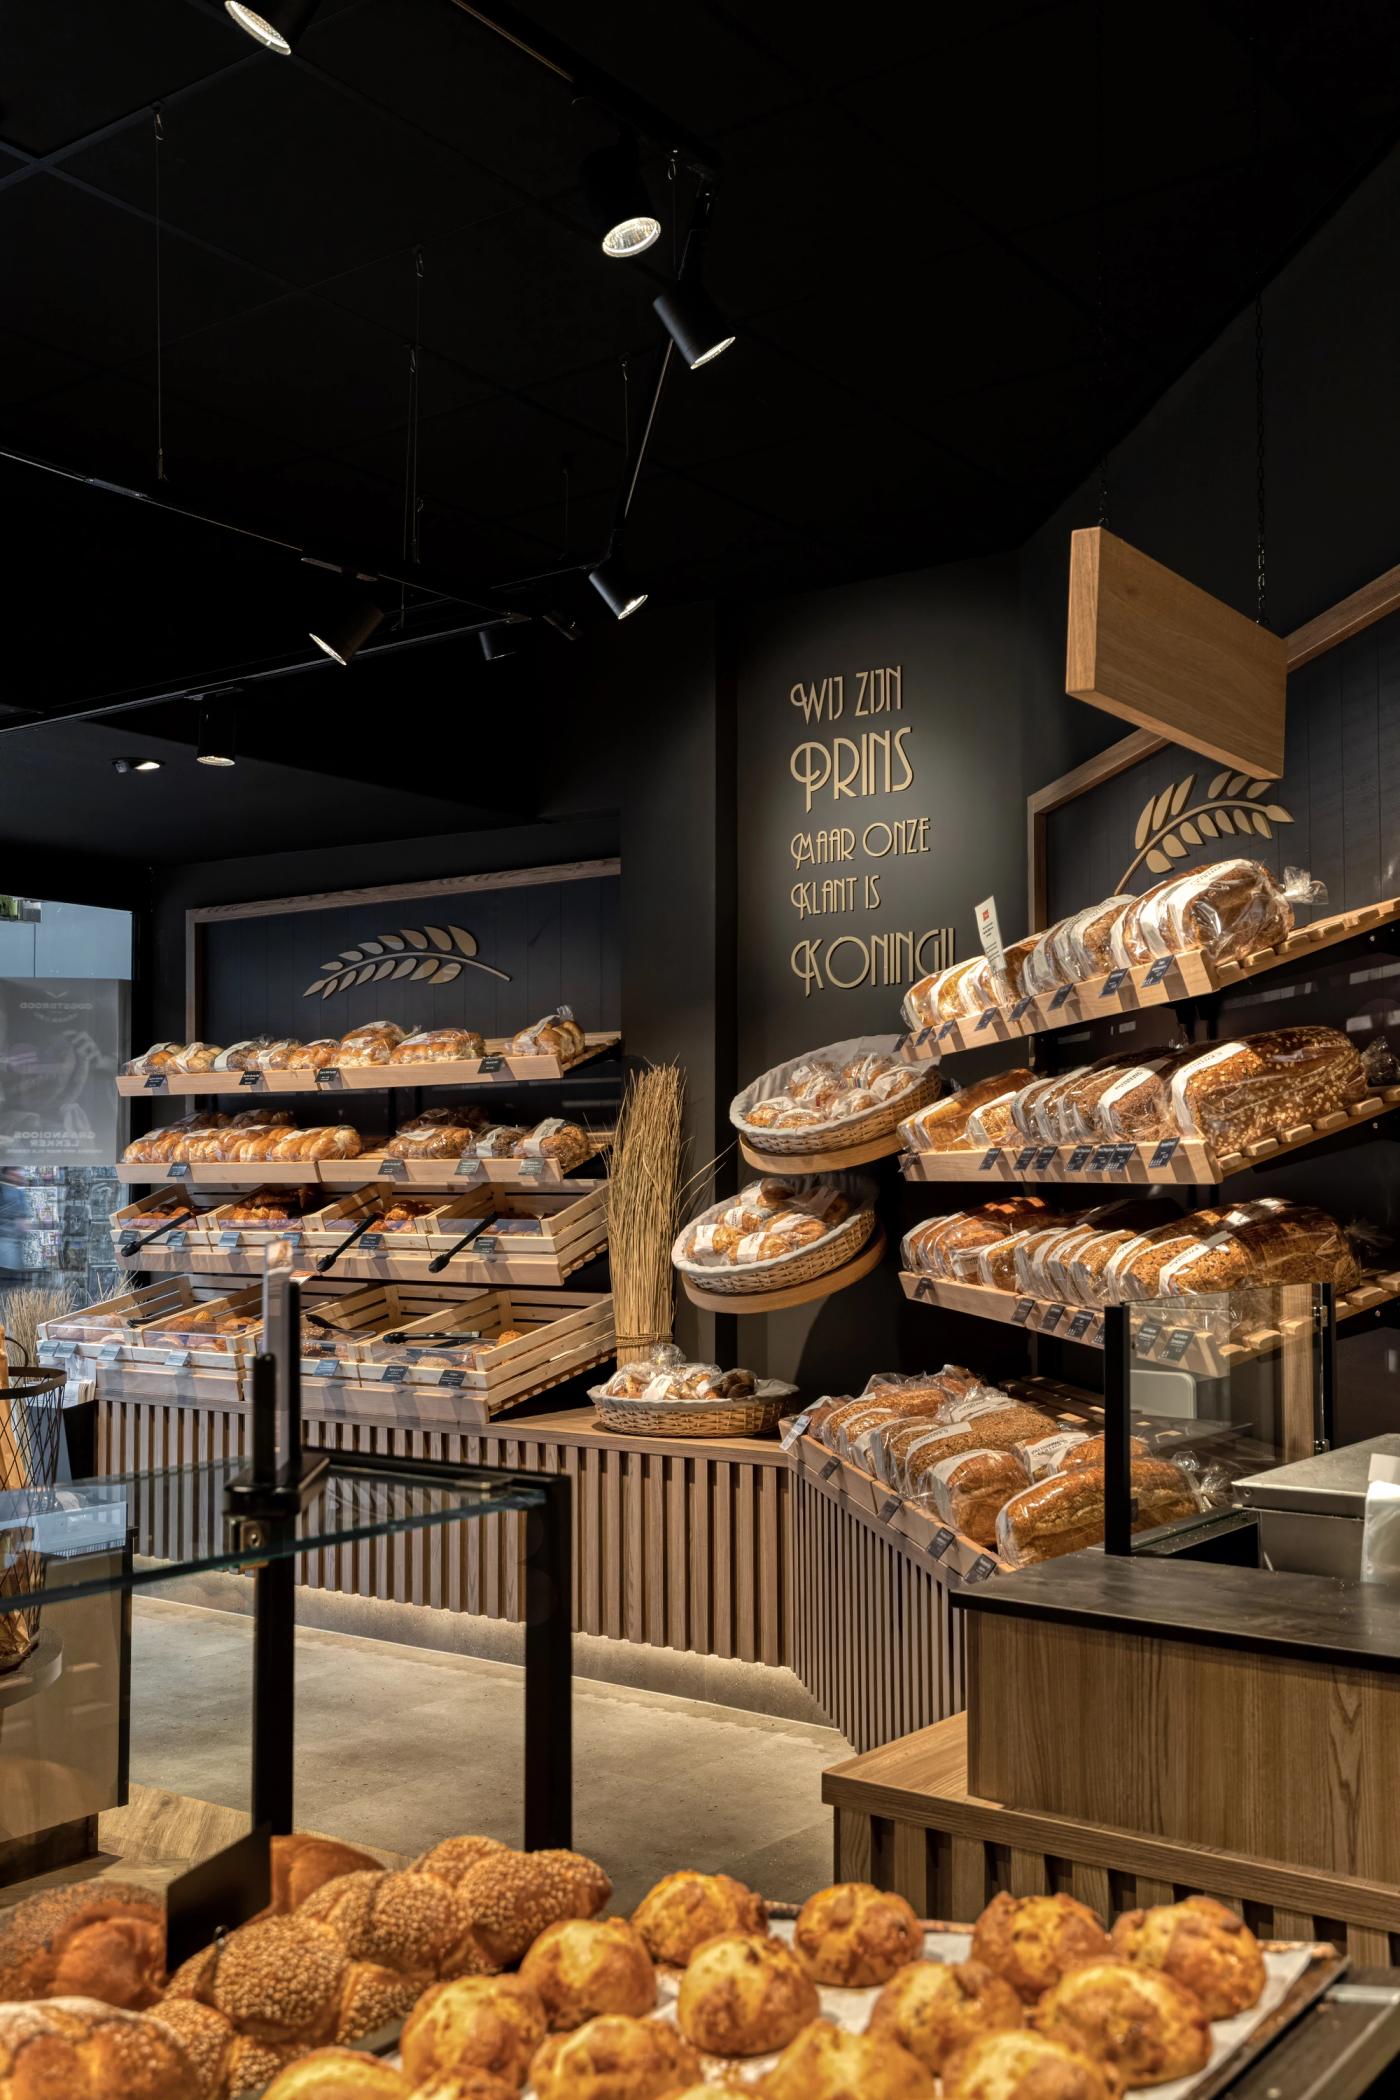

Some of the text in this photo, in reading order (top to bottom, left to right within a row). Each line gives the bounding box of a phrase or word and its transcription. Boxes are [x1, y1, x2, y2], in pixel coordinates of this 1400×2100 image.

[791, 665, 903, 725] WIJ ZIJN
[790, 726, 914, 813] PRINS
[790, 817, 931, 869] MAAR ONZE
[790, 875, 881, 919] KLANT IS
